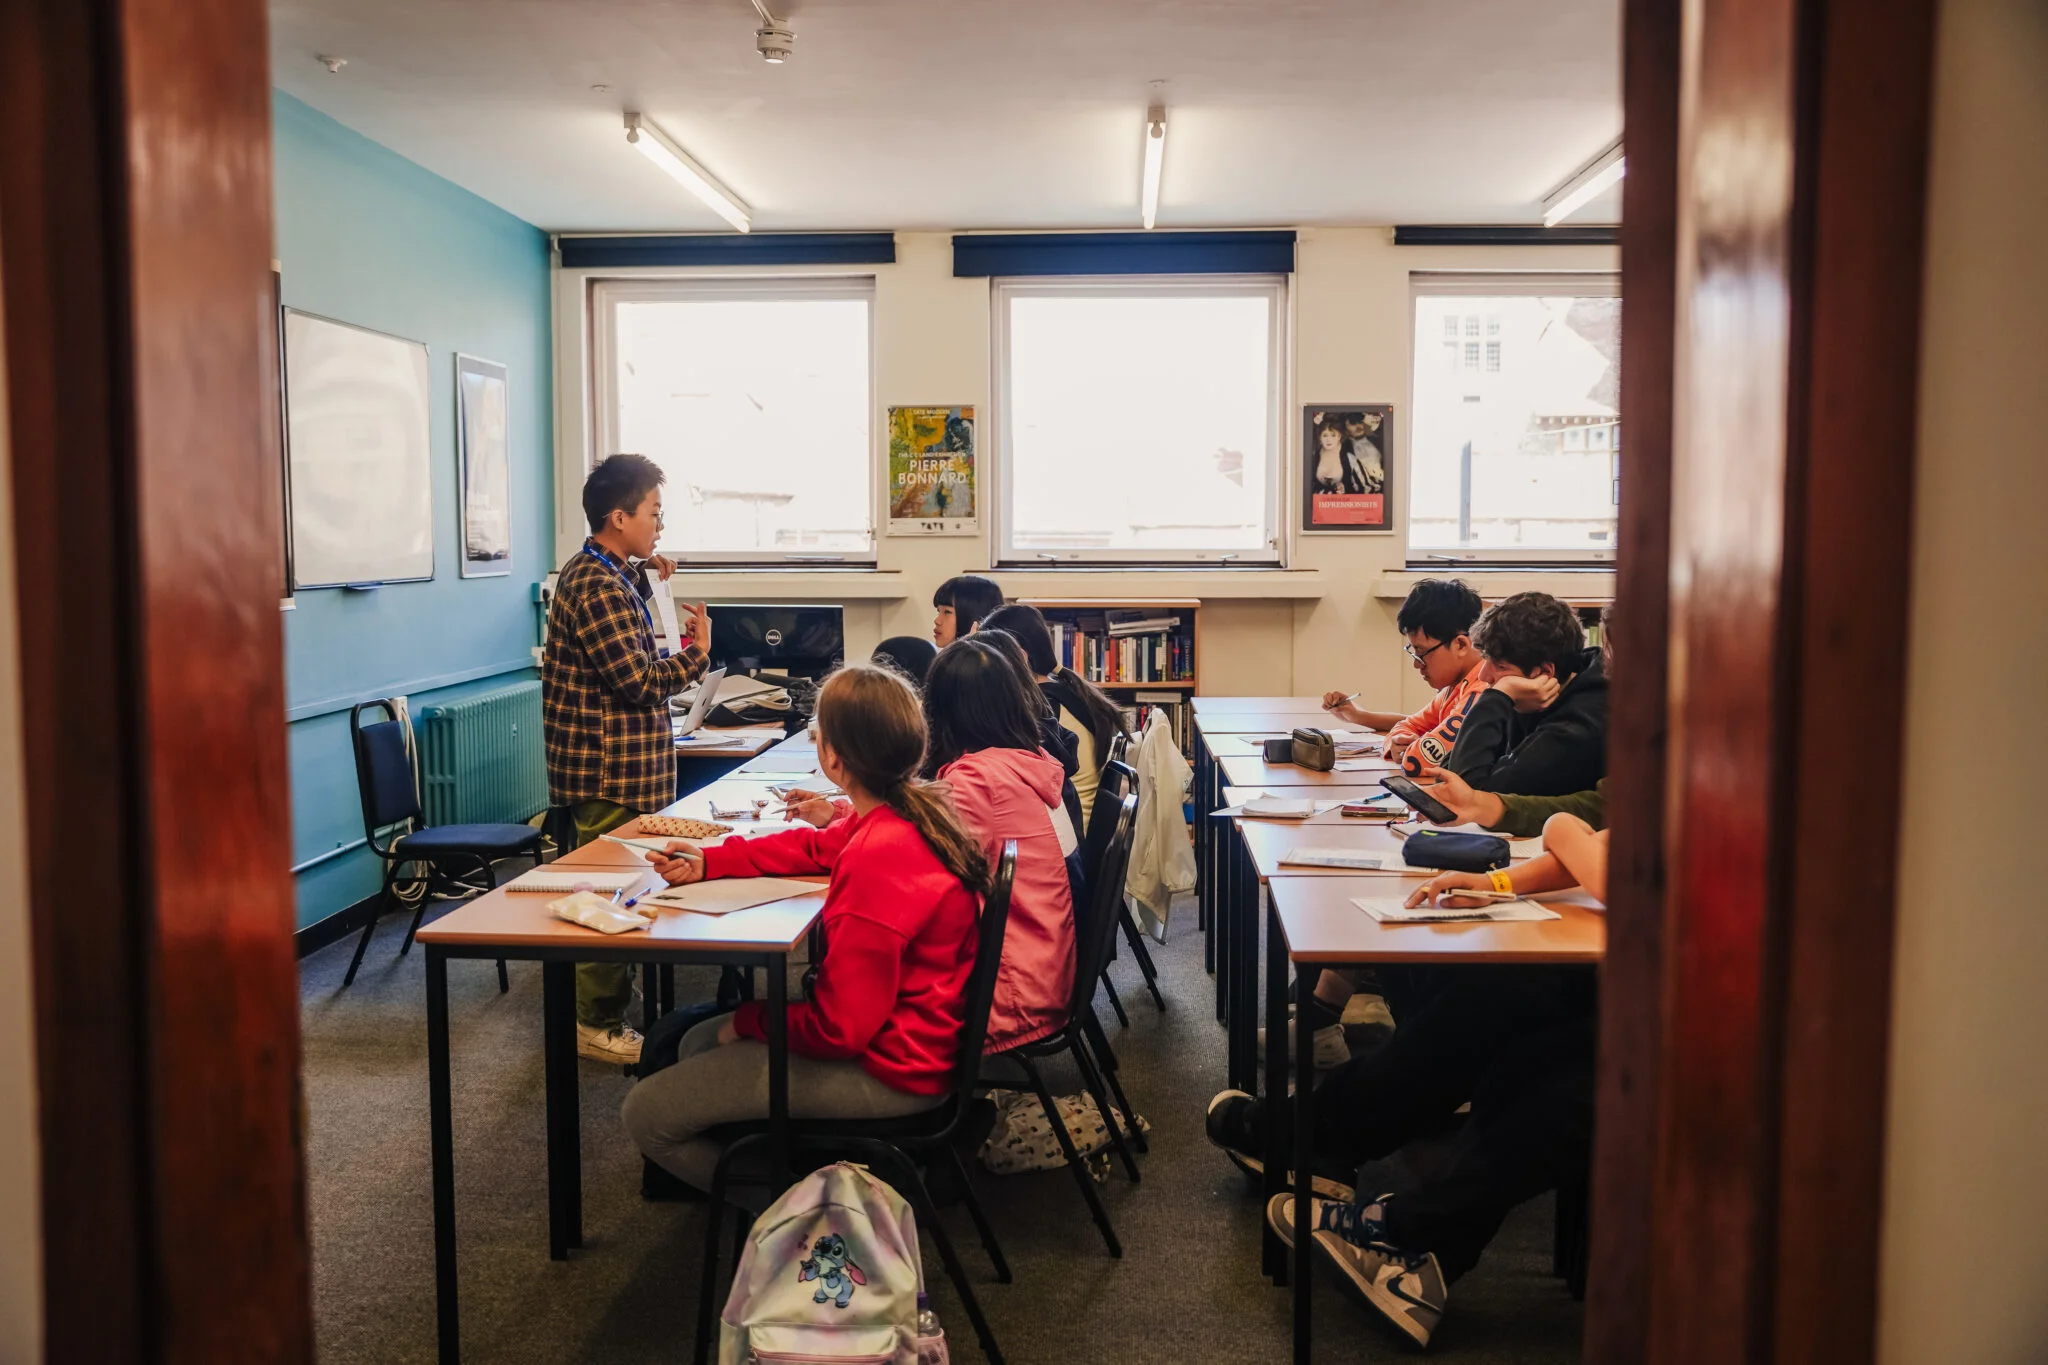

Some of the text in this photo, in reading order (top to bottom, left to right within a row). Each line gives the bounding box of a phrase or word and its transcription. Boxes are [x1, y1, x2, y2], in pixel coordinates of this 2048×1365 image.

[910, 460, 954, 472] PIERRE
[898, 473, 966, 485] BONNARD
[1423, 740, 1443, 760] CALI
